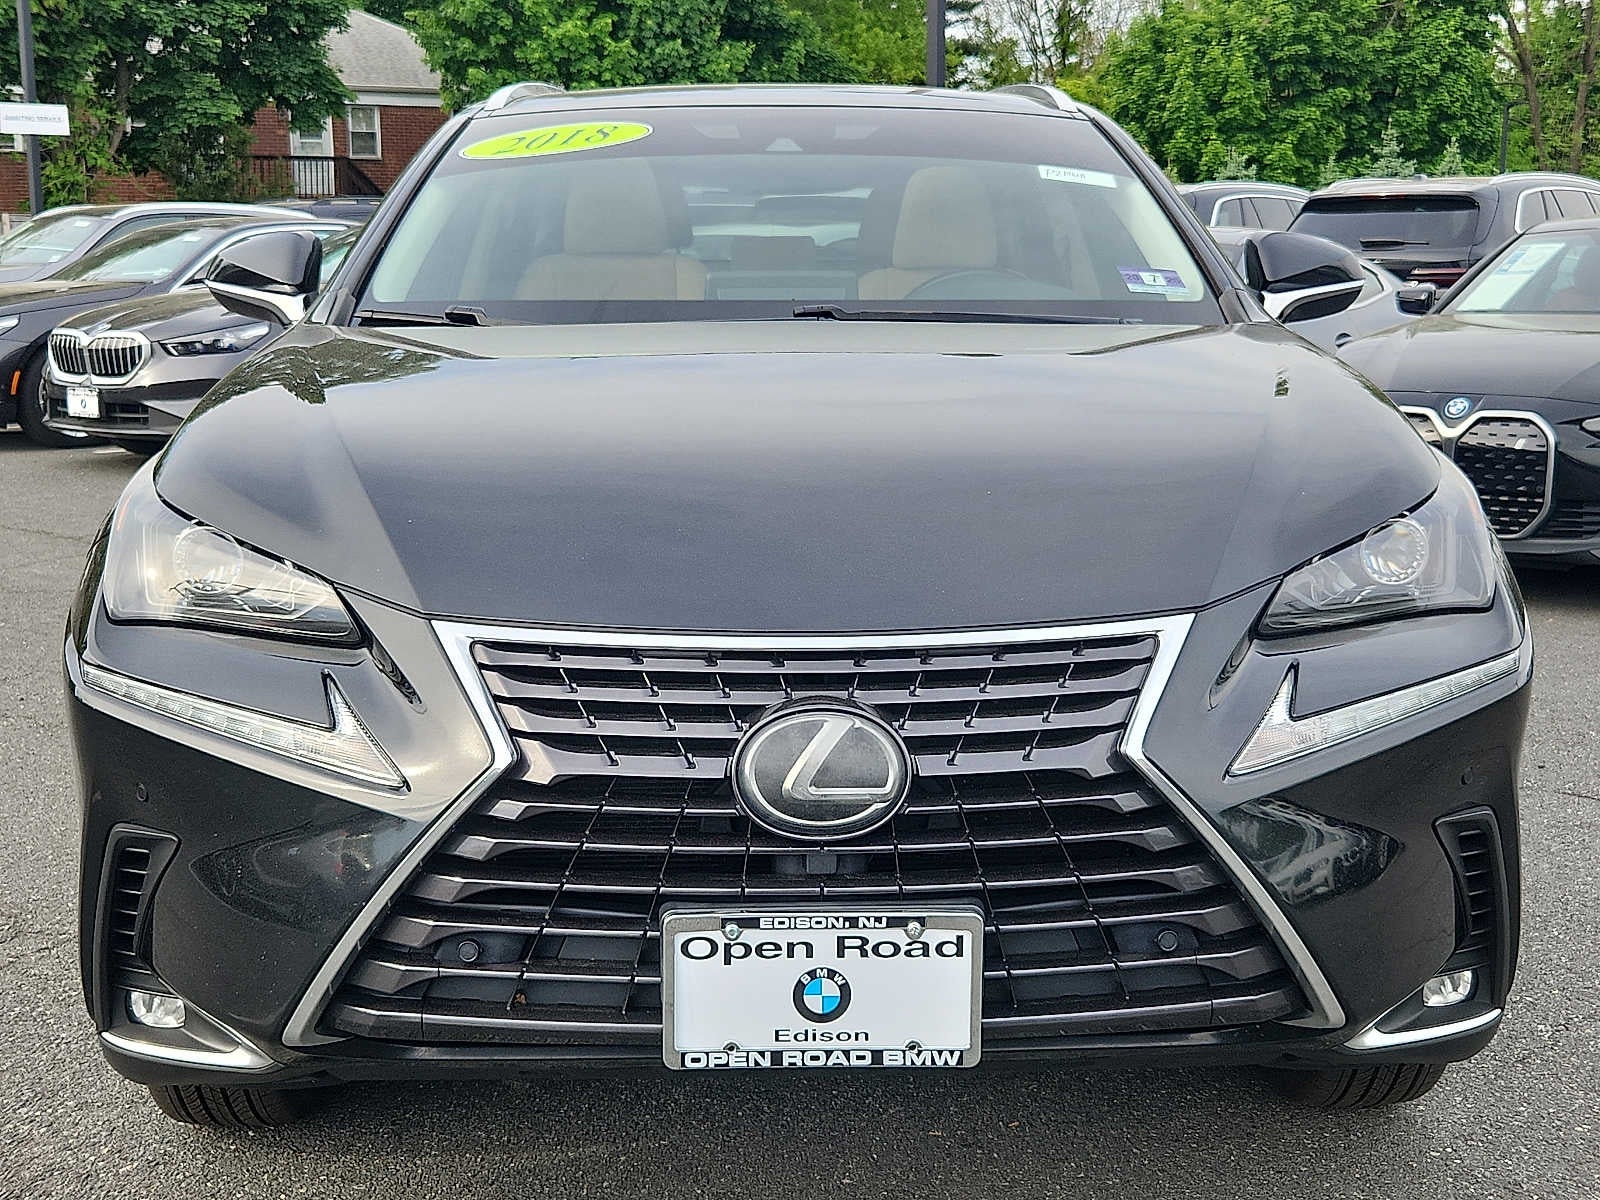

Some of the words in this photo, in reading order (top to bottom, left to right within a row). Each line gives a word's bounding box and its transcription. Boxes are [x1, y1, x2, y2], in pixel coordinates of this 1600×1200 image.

[491, 126, 618, 155] 2018
[759, 917, 849, 929] EDISON,
[858, 917, 887, 928] NJ
[680, 936, 814, 965] Open
[836, 935, 964, 958] Road
[801, 969, 846, 985] BMW
[774, 1029, 869, 1042] Edison
[684, 1052, 770, 1067] OPEN
[783, 1051, 871, 1066] ROAD
[883, 1051, 962, 1066] BMW
